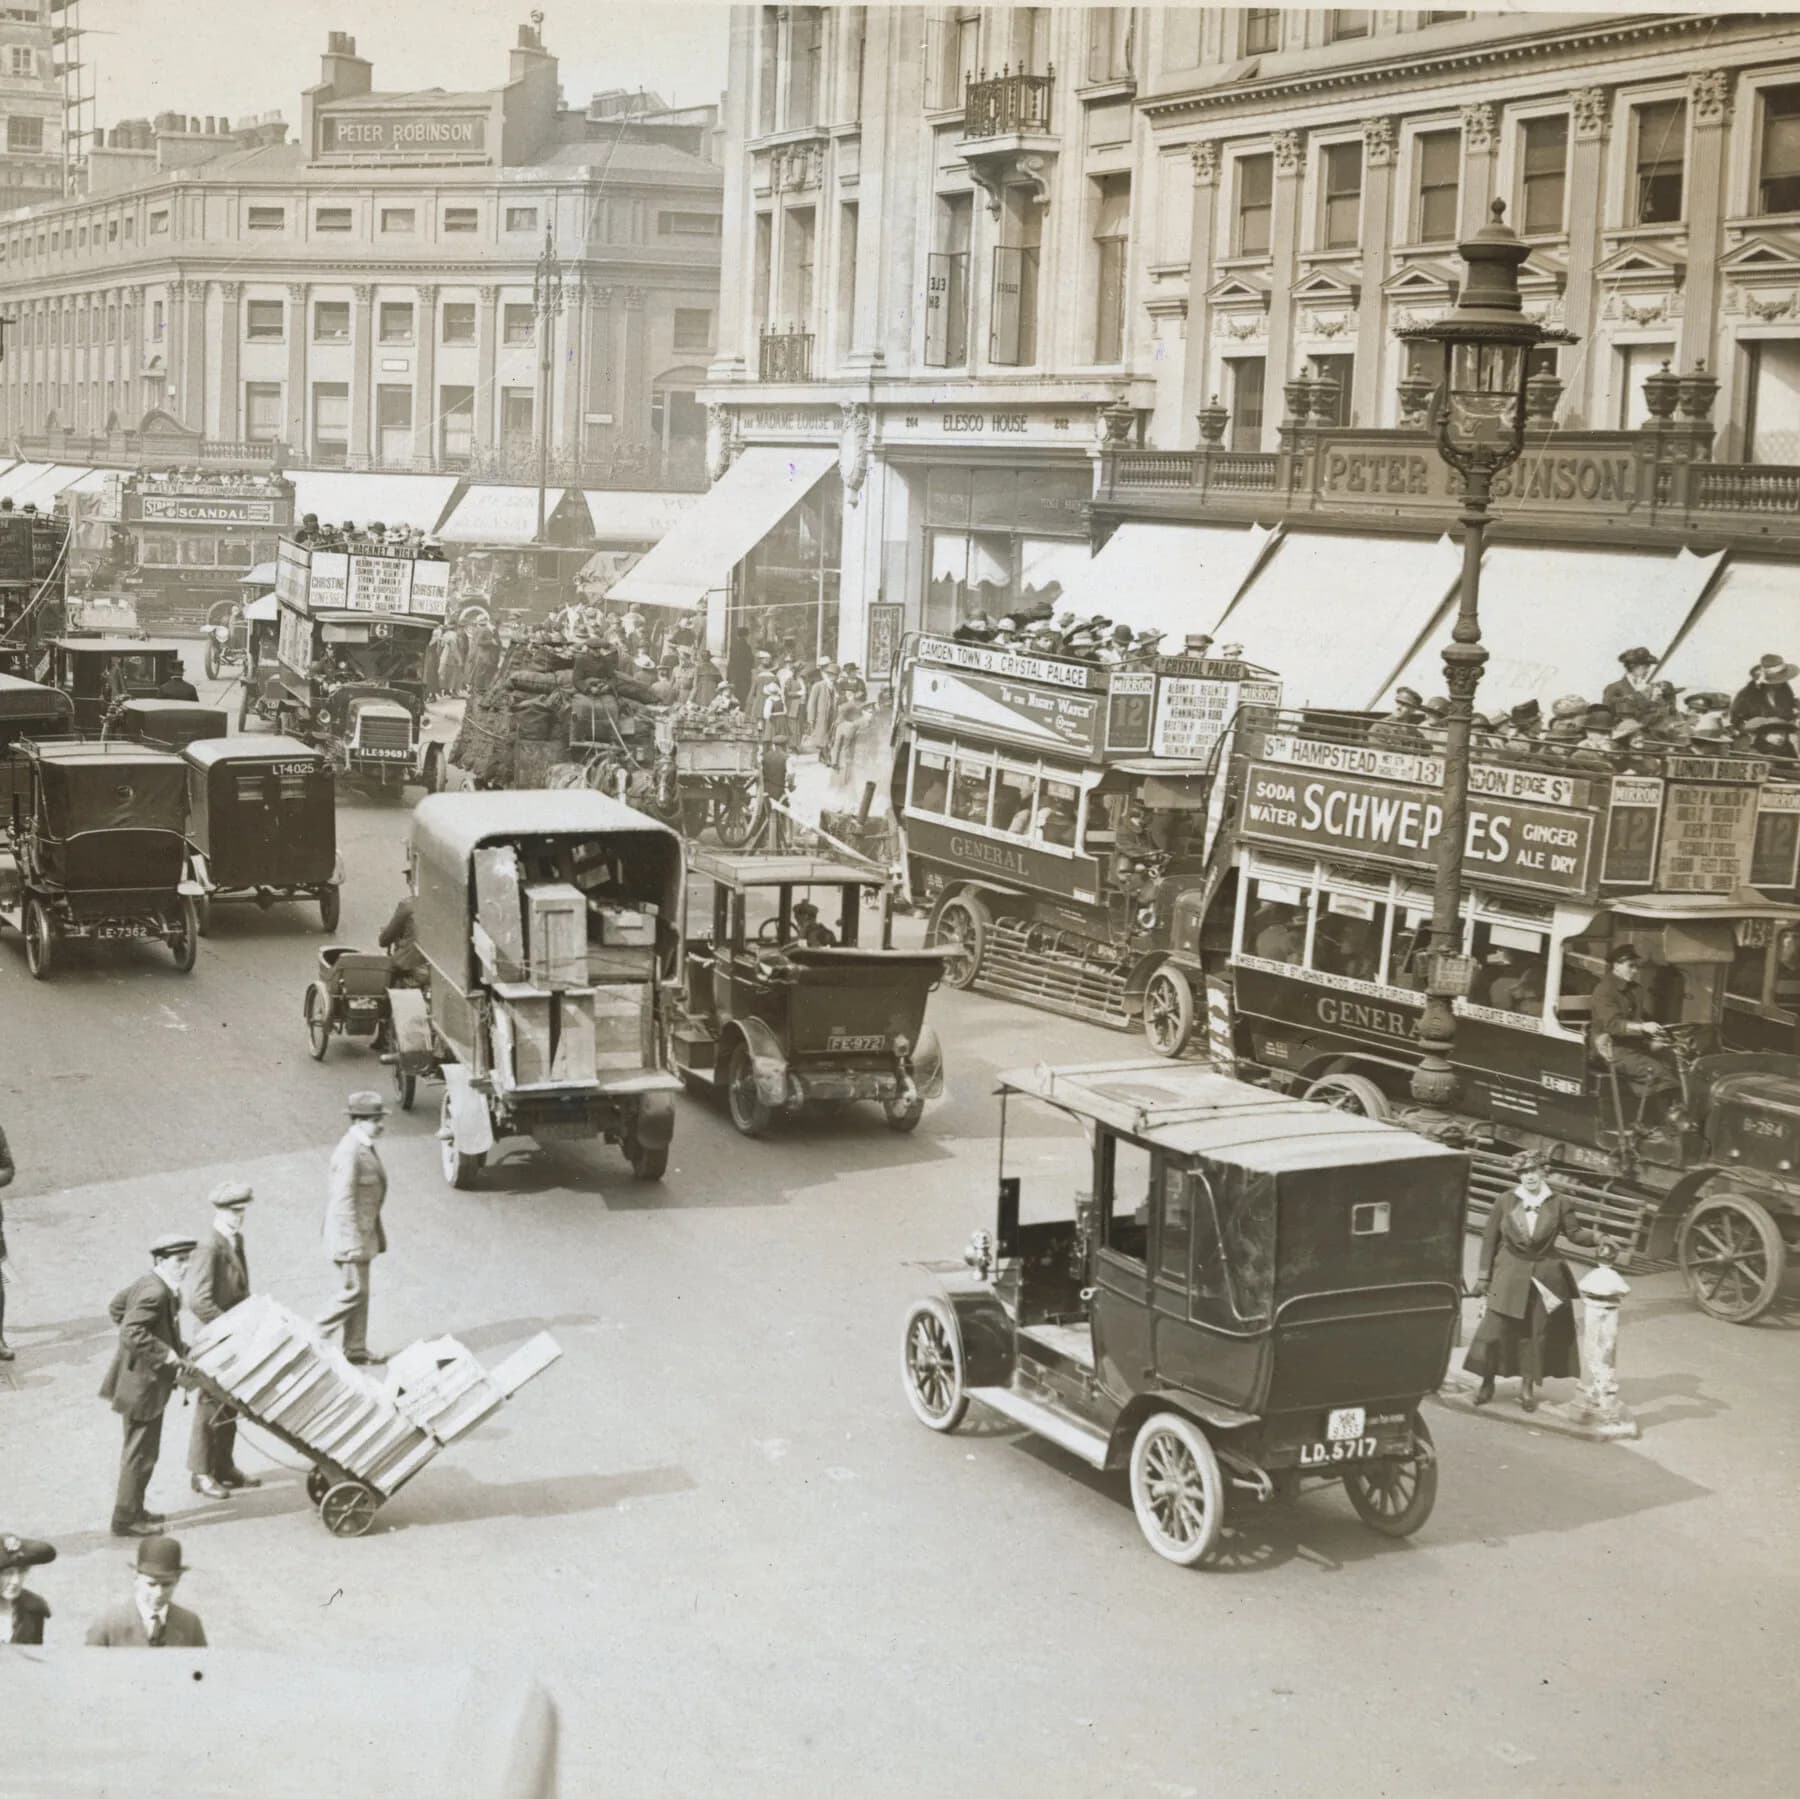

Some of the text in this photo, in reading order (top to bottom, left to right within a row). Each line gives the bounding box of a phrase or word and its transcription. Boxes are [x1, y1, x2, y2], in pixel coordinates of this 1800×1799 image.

[337, 123, 472, 142] PETER ROBINSON
[943, 414, 1028, 433] ELESCO HOUSE
[1327, 452, 1630, 501] PETER RBINSON
[179, 507, 247, 520] SCANDAL
[353, 544, 388, 556] HACKNEY
[375, 623, 388, 638] 6
[920, 641, 1084, 686] CAMDEN TOWN 3 CRYSTAL PALACE
[1164, 658, 1241, 677] CRYSTAL PALACE
[1113, 679, 1153, 691] MIRROR
[1239, 686, 1277, 699] MIRROR
[1113, 697, 1145, 727] 12
[1291, 740, 1377, 773] HAMPSTEAD
[1256, 781, 1296, 802] SODA
[1615, 785, 1659, 801] MIRROR
[1250, 804, 1297, 827] WATER
[1301, 783, 1512, 863] SCHWEPES
[1522, 823, 1579, 848] GINGER
[1614, 810, 1650, 852] 12
[950, 836, 1029, 876] GENERAL
[1516, 849, 1577, 874] ALE DRY
